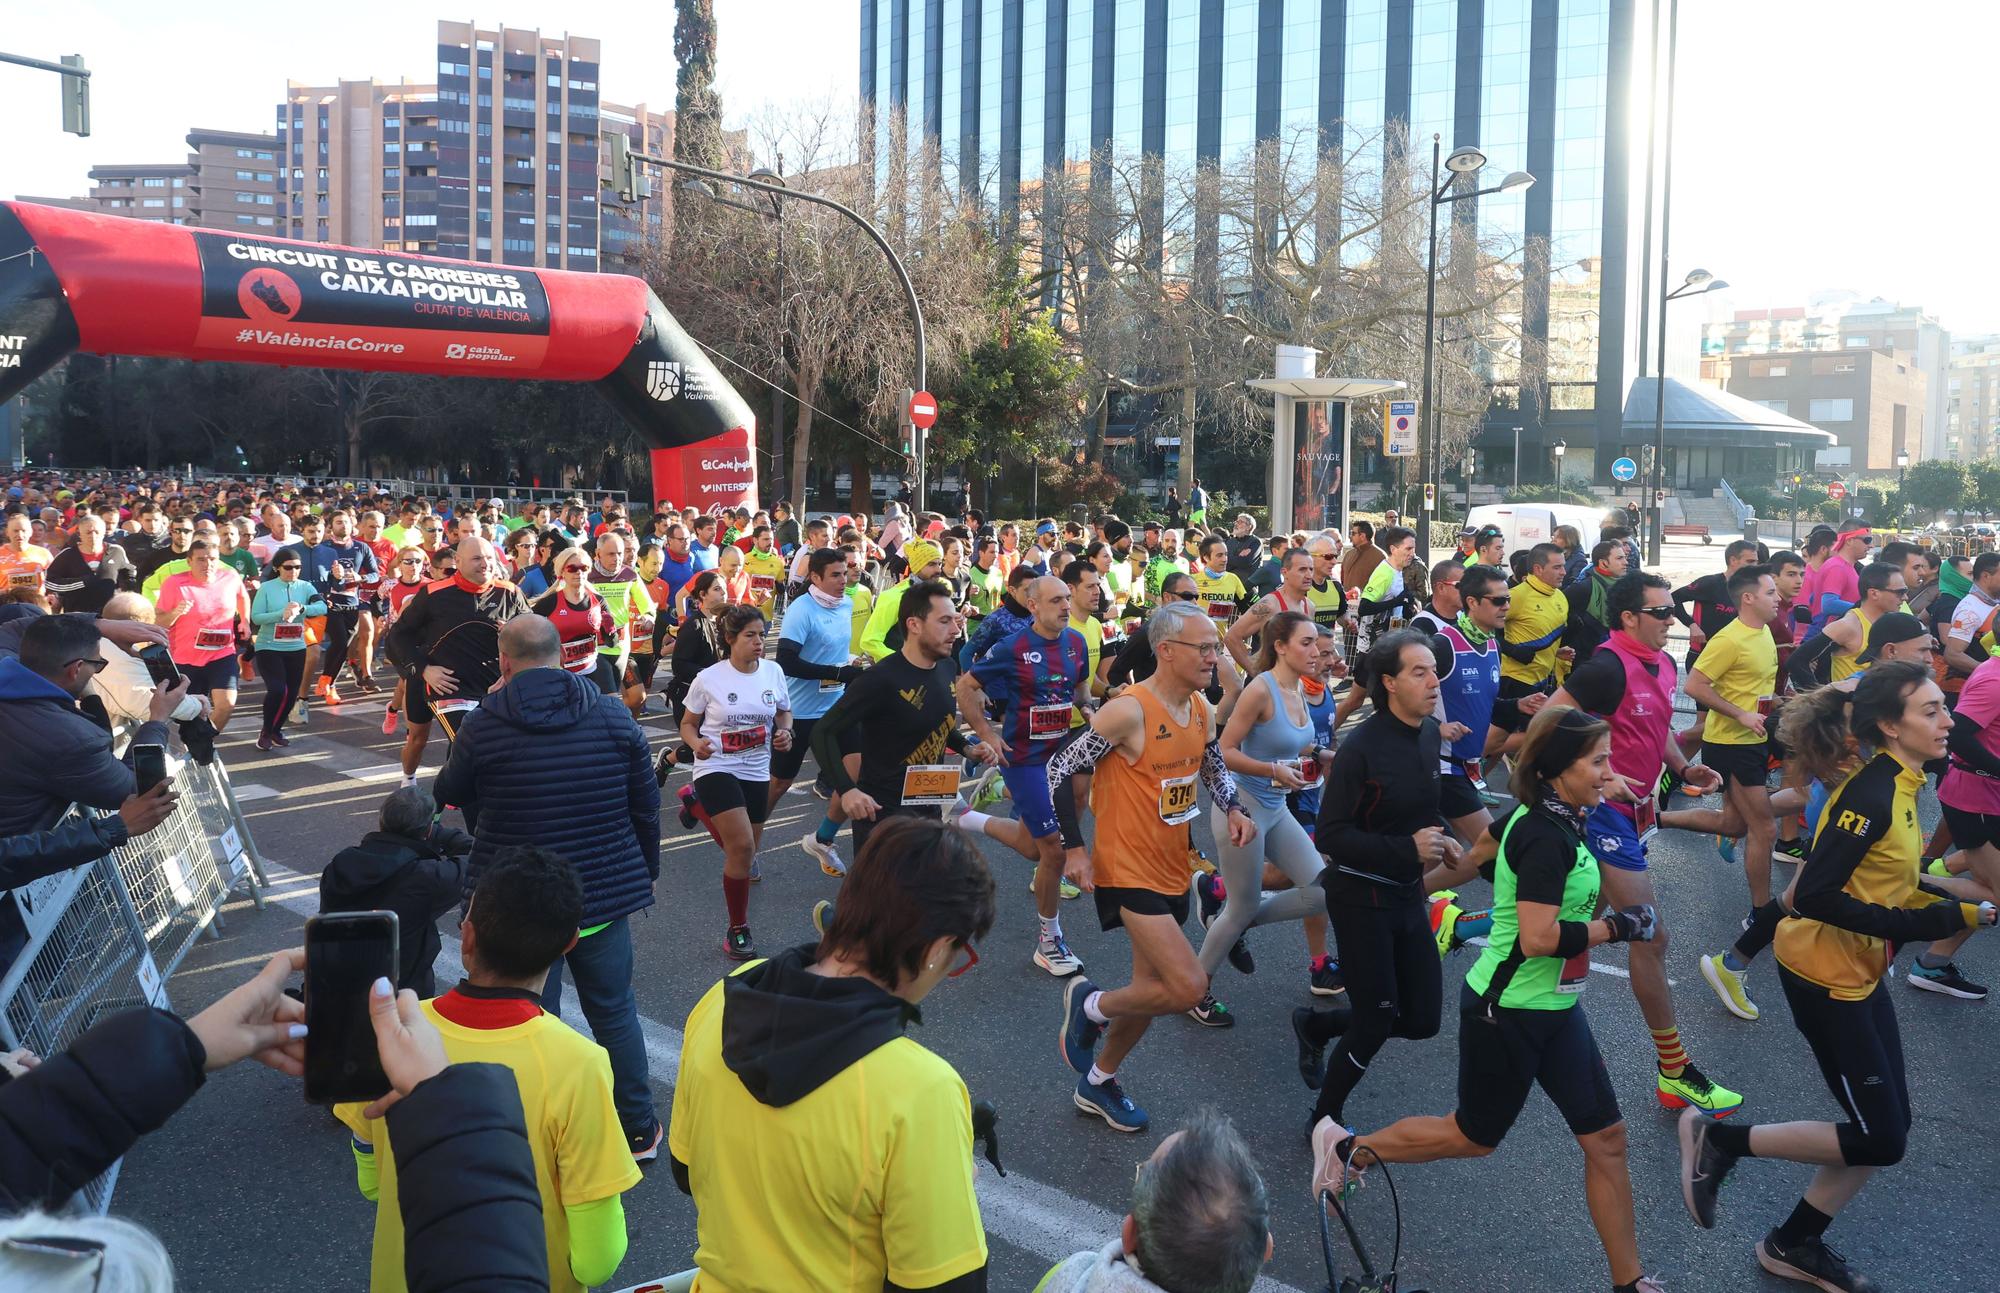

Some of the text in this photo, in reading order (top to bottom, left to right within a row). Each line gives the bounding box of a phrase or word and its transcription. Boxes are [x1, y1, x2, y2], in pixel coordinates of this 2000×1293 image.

[227, 243, 521, 290] CIRCUIT DE CARRERES
[414, 302, 531, 322] CIUTAT DE VALÈNCIA
[236, 329, 404, 353] #ValènciaCorre
[469, 345, 501, 354] caixa
[467, 352, 515, 362] popular
[1297, 453, 1340, 461] SAUVAGE
[727, 713, 773, 722] PIONEROS
[1858, 818, 1871, 837] TEAM
